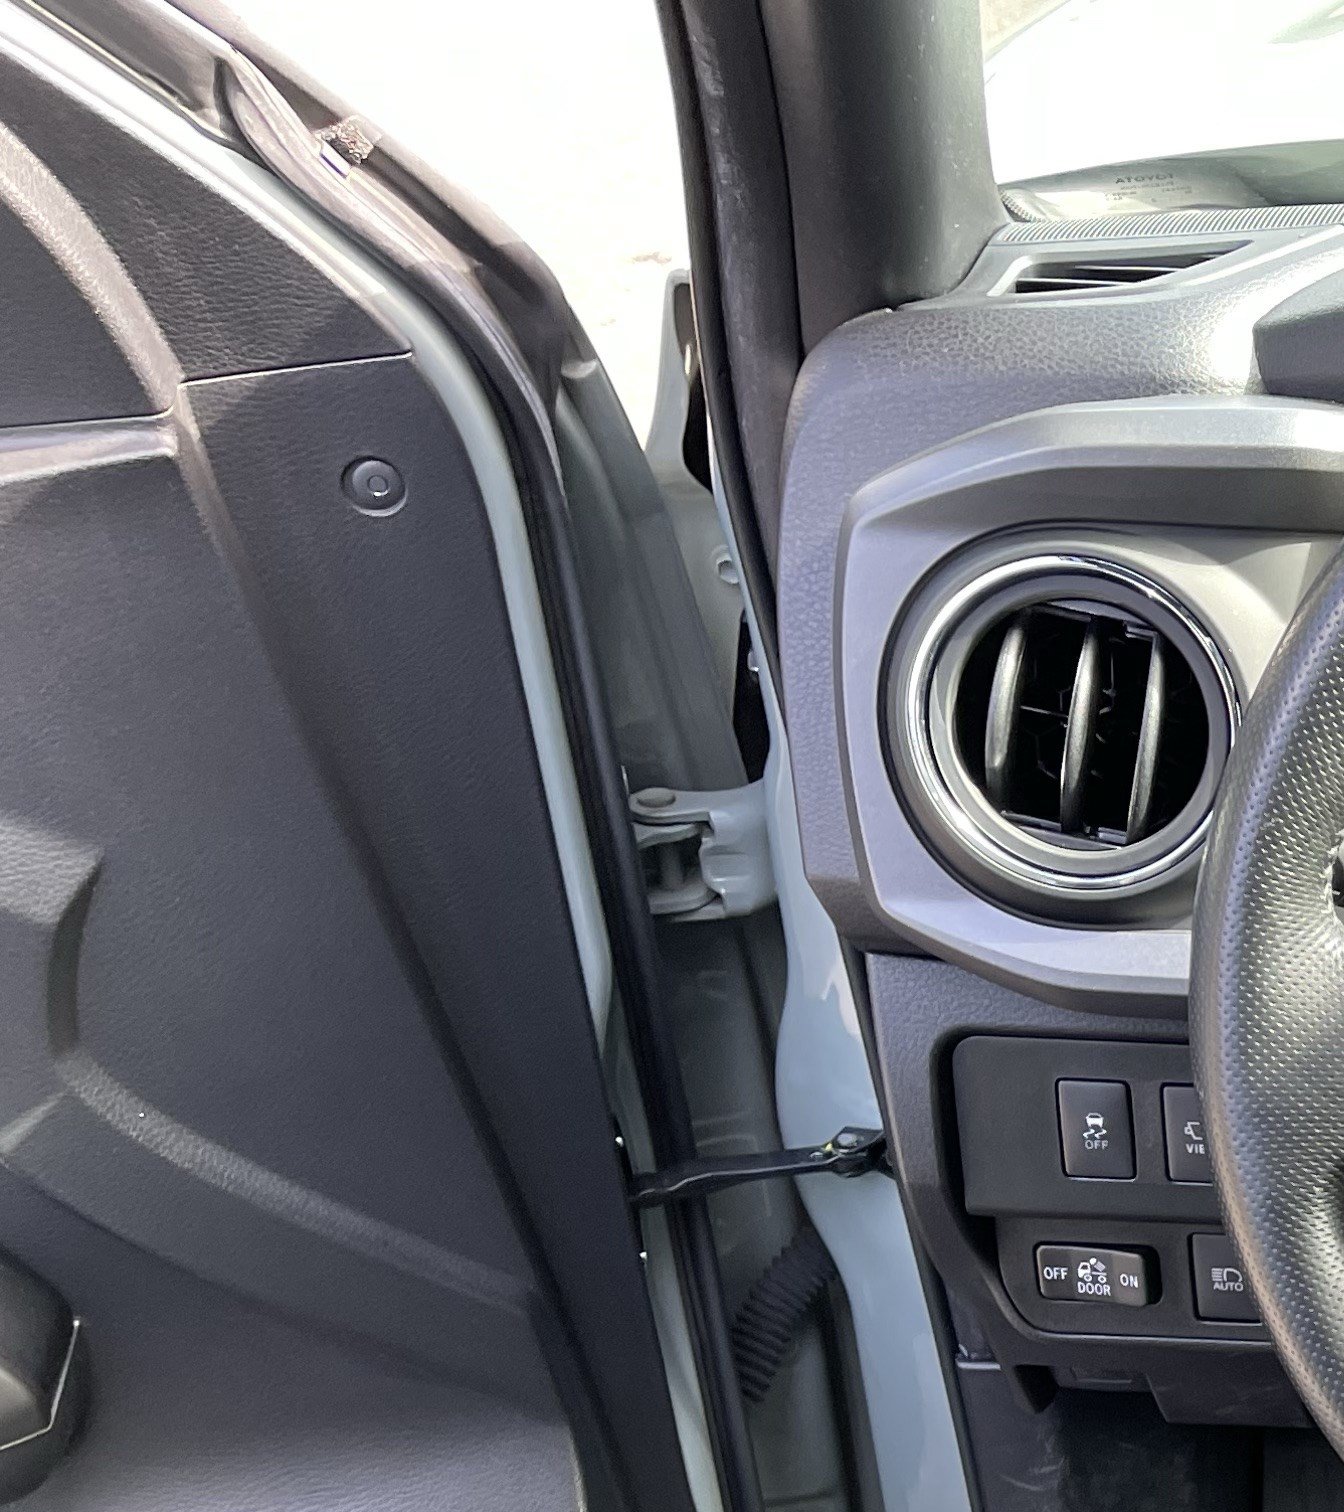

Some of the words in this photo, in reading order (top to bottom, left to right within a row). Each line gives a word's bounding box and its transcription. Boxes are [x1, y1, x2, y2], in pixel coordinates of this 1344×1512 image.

[1084, 1140, 1109, 1150] OFF
[1185, 1143, 1205, 1154] VIE
[1044, 1266, 1069, 1280] OFF
[1120, 1274, 1139, 1288] ON
[1213, 1281, 1244, 1292] AUTO
[1077, 1282, 1112, 1296] DOOR
